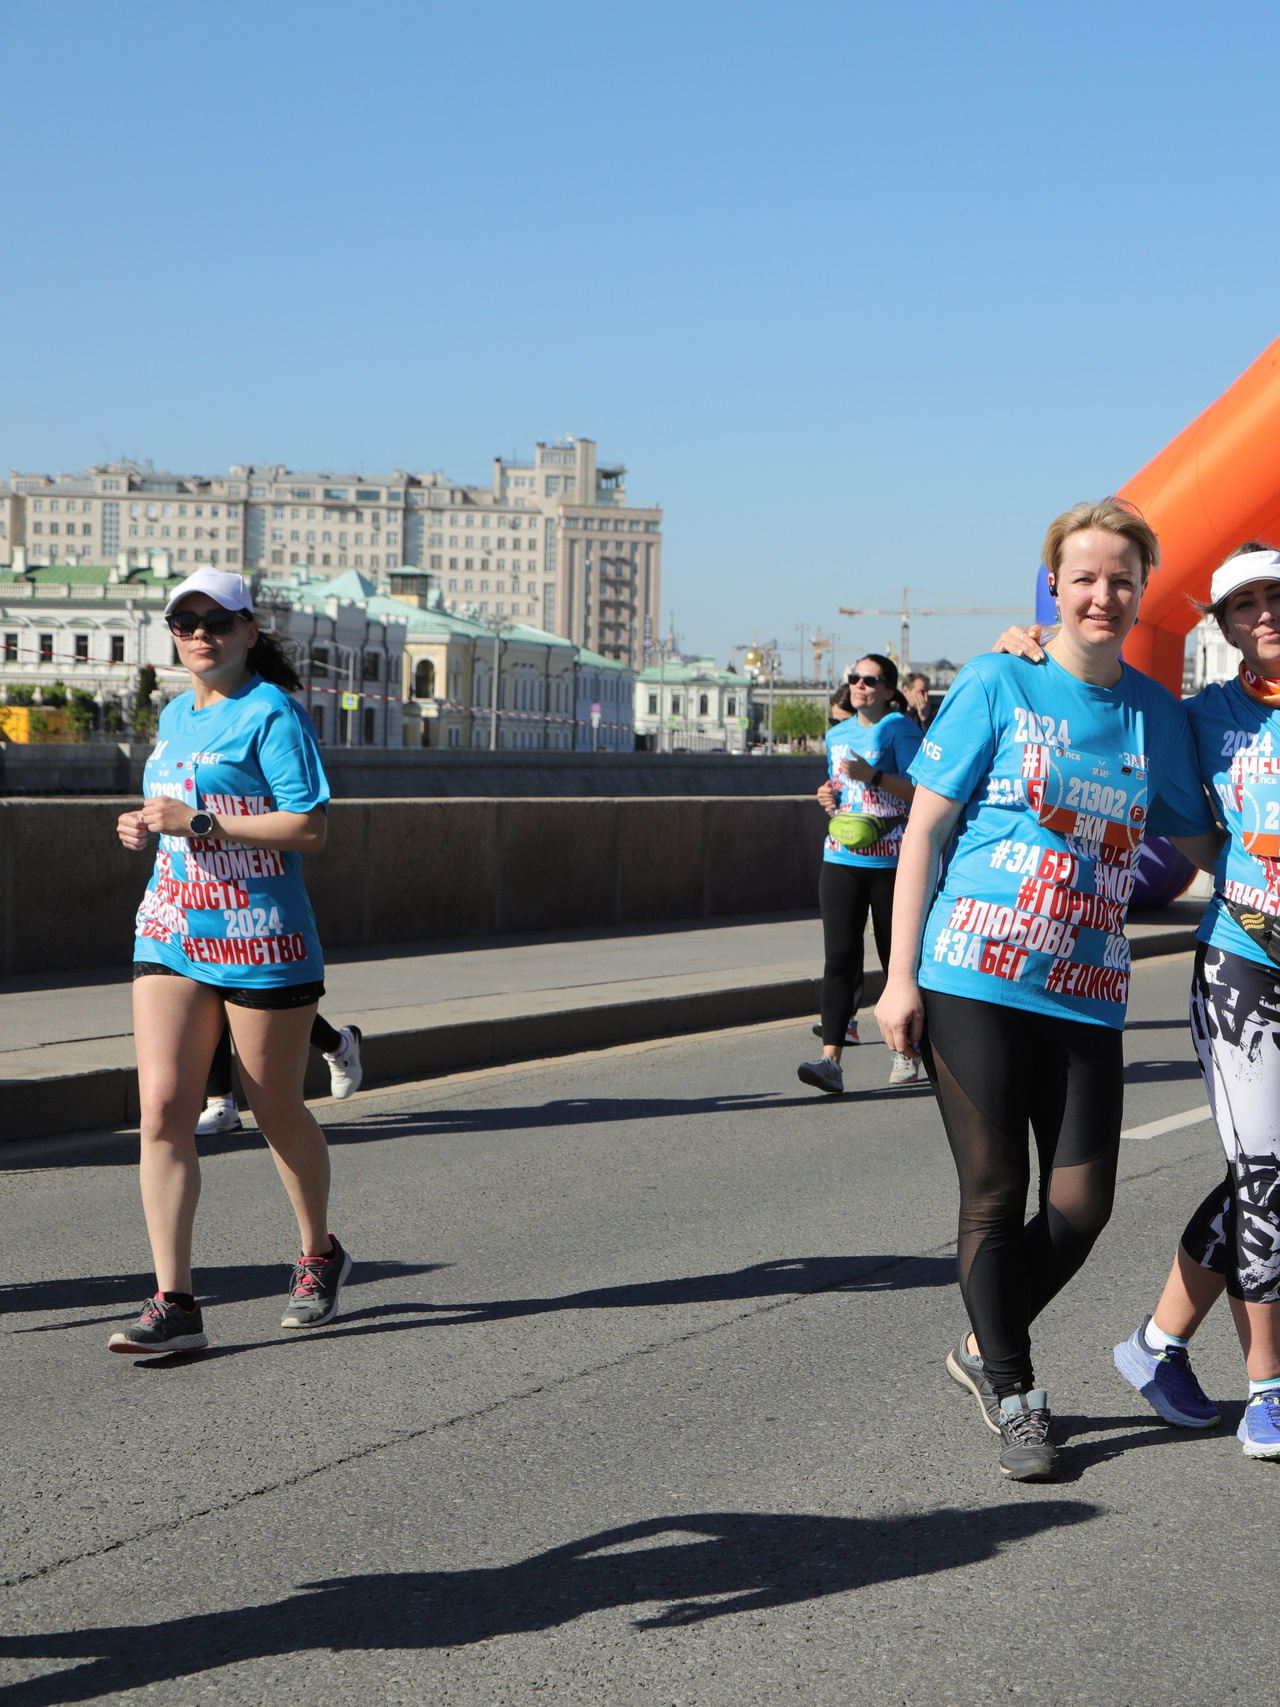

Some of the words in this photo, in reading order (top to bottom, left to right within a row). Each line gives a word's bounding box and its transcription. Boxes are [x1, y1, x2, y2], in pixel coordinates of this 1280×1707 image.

[1013, 707, 1071, 749] 2024
[1221, 730, 1274, 757] 2024
[1065, 752, 1081, 761] ПСБ
[1260, 777, 1277, 785] ПСБ
[1065, 777, 1128, 820] 21302
[184, 850, 286, 881] #МОМЕНТ
[990, 839, 1080, 888] #ЗАБЕГ
[223, 906, 284, 938] 2024
[948, 897, 1081, 959] #ЛЮБОВЬ
[181, 932, 307, 964] #ЕДИНСТВО
[933, 928, 1030, 983] #ЗАБЕГ
